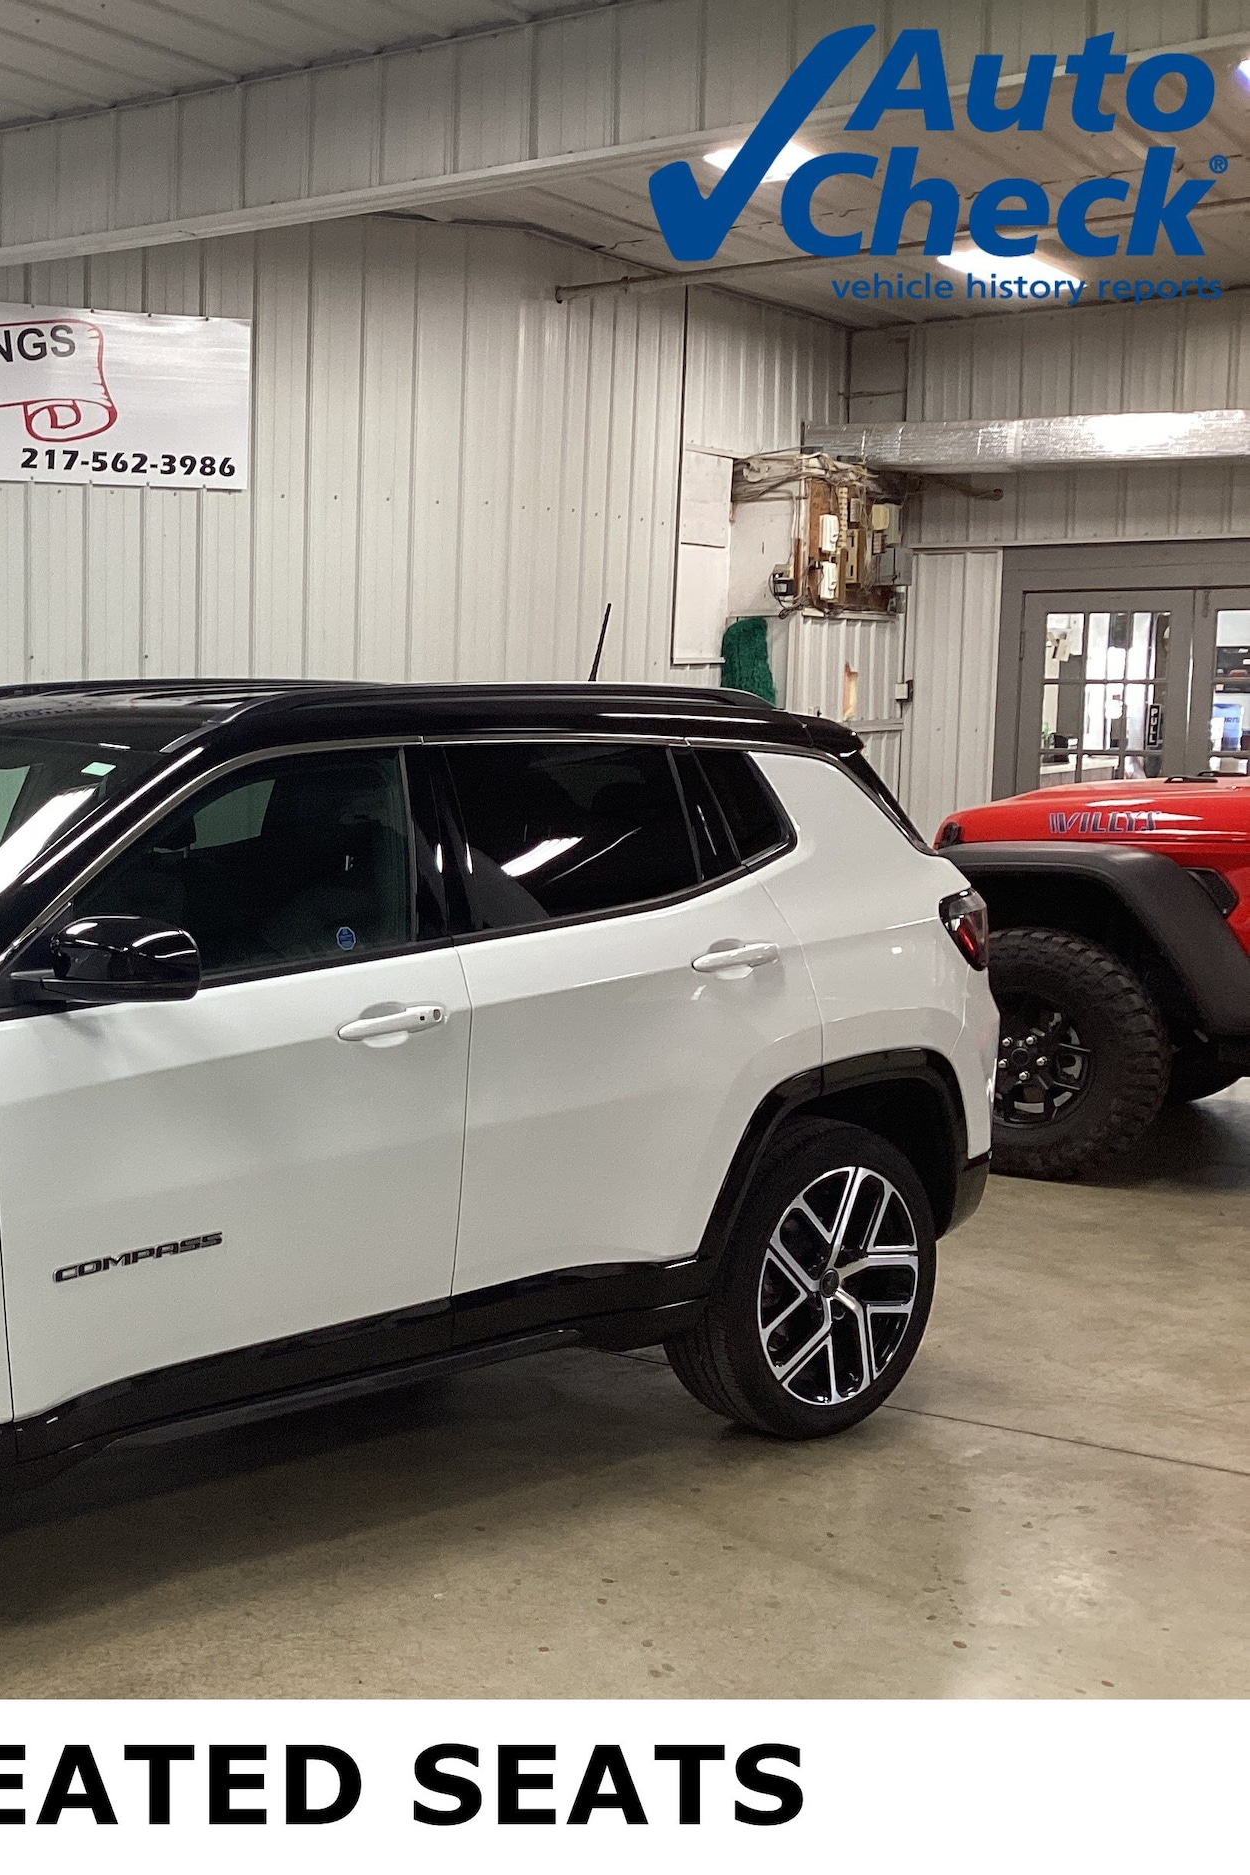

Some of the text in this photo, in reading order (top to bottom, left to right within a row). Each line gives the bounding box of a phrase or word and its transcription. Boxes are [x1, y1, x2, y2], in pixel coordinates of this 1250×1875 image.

[21, 447, 236, 478] 217-562-3986
[1149, 707, 1159, 746] PULL
[1049, 811, 1161, 834] WILLYS
[53, 1231, 223, 1282] COMPASS
